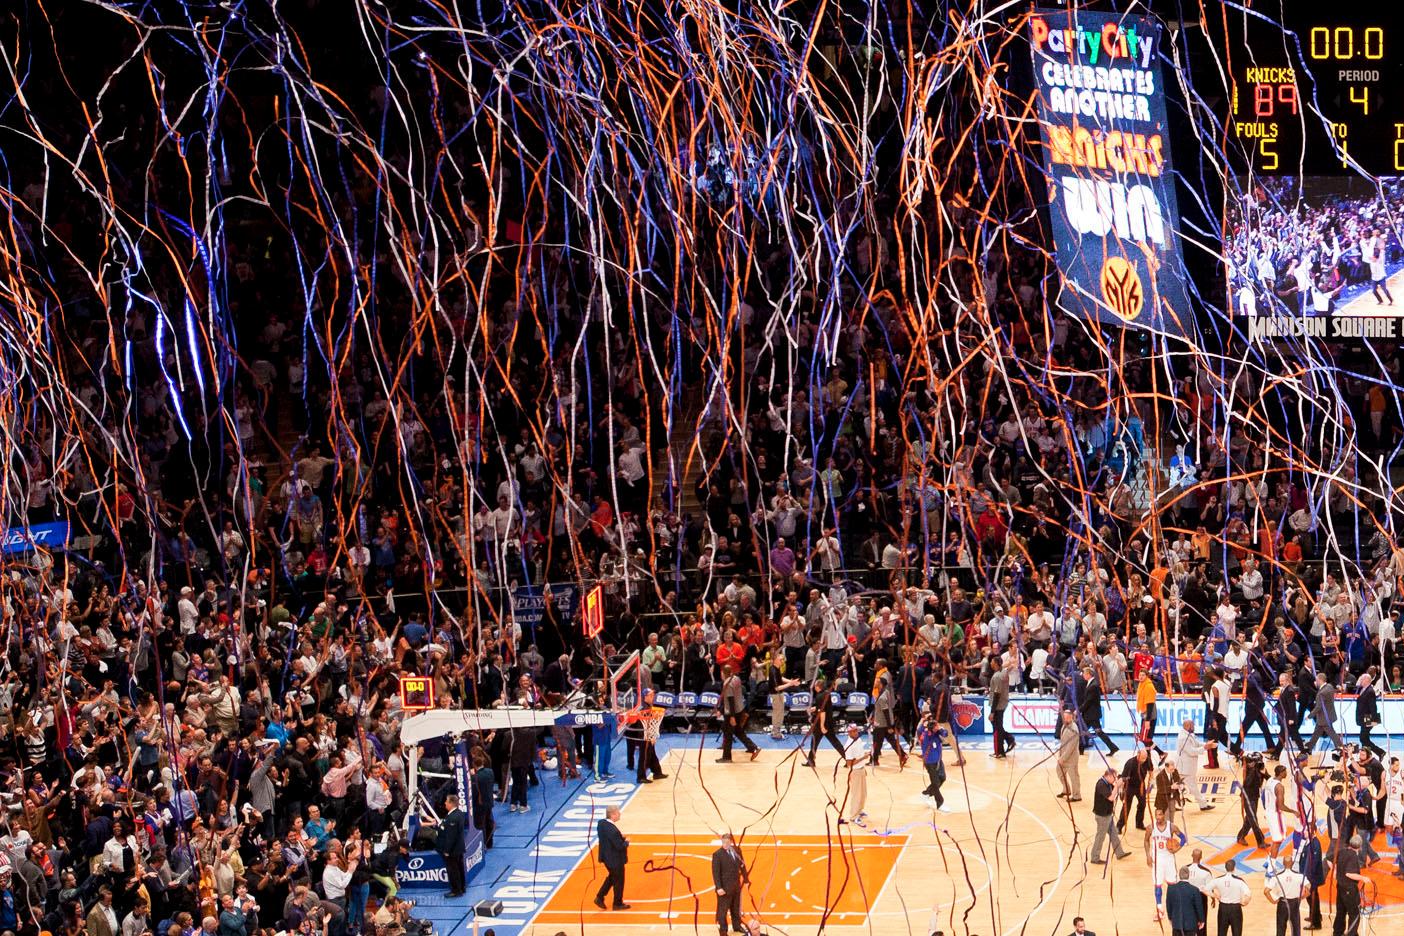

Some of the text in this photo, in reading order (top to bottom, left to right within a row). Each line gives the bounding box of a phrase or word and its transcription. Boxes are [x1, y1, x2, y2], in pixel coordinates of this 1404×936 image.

[1311, 27, 1383, 59] 00.0
[1042, 62, 1155, 95] CELEBRATES
[1247, 68, 1296, 83] KNICKS
[1339, 70, 1379, 81] PERIOD
[1050, 87, 1151, 122] ANOTHER
[1254, 85, 1296, 116] 89
[1350, 87, 1368, 115] 4
[1236, 123, 1278, 137] FOULS
[1331, 124, 1347, 138] TO
[1260, 139, 1278, 170] 5
[1249, 316, 1326, 344] MADISON
[1332, 317, 1396, 338] SQUARE
[574, 713, 604, 725] @NBA
[529, 782, 636, 857] KNICKS
[395, 867, 449, 882] PALDING
